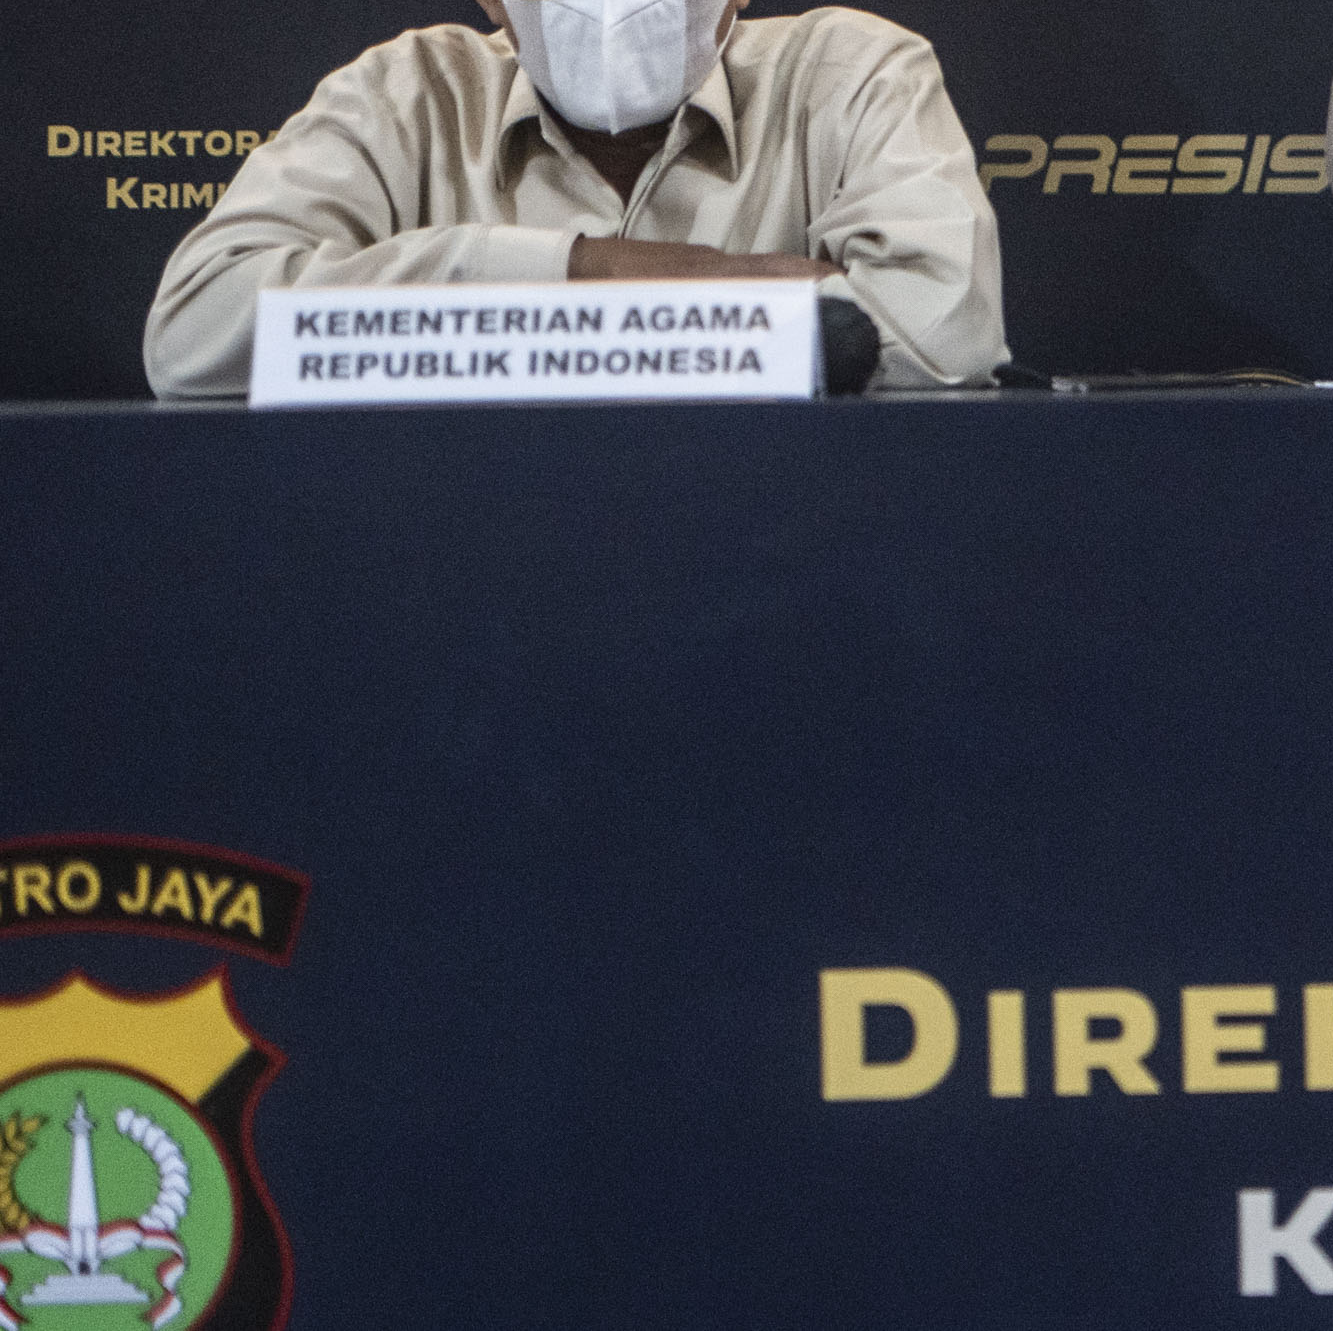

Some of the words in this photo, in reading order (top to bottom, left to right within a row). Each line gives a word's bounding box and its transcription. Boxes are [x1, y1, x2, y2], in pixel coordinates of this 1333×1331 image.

[980, 134, 1330, 194] PRESIS
[294, 307, 604, 338] KEMENTERIAN
[619, 304, 771, 333] AGAMA
[298, 350, 510, 381] REPUBLIK
[528, 347, 763, 376] INDONESIA
[116, 863, 264, 938] JAYA
